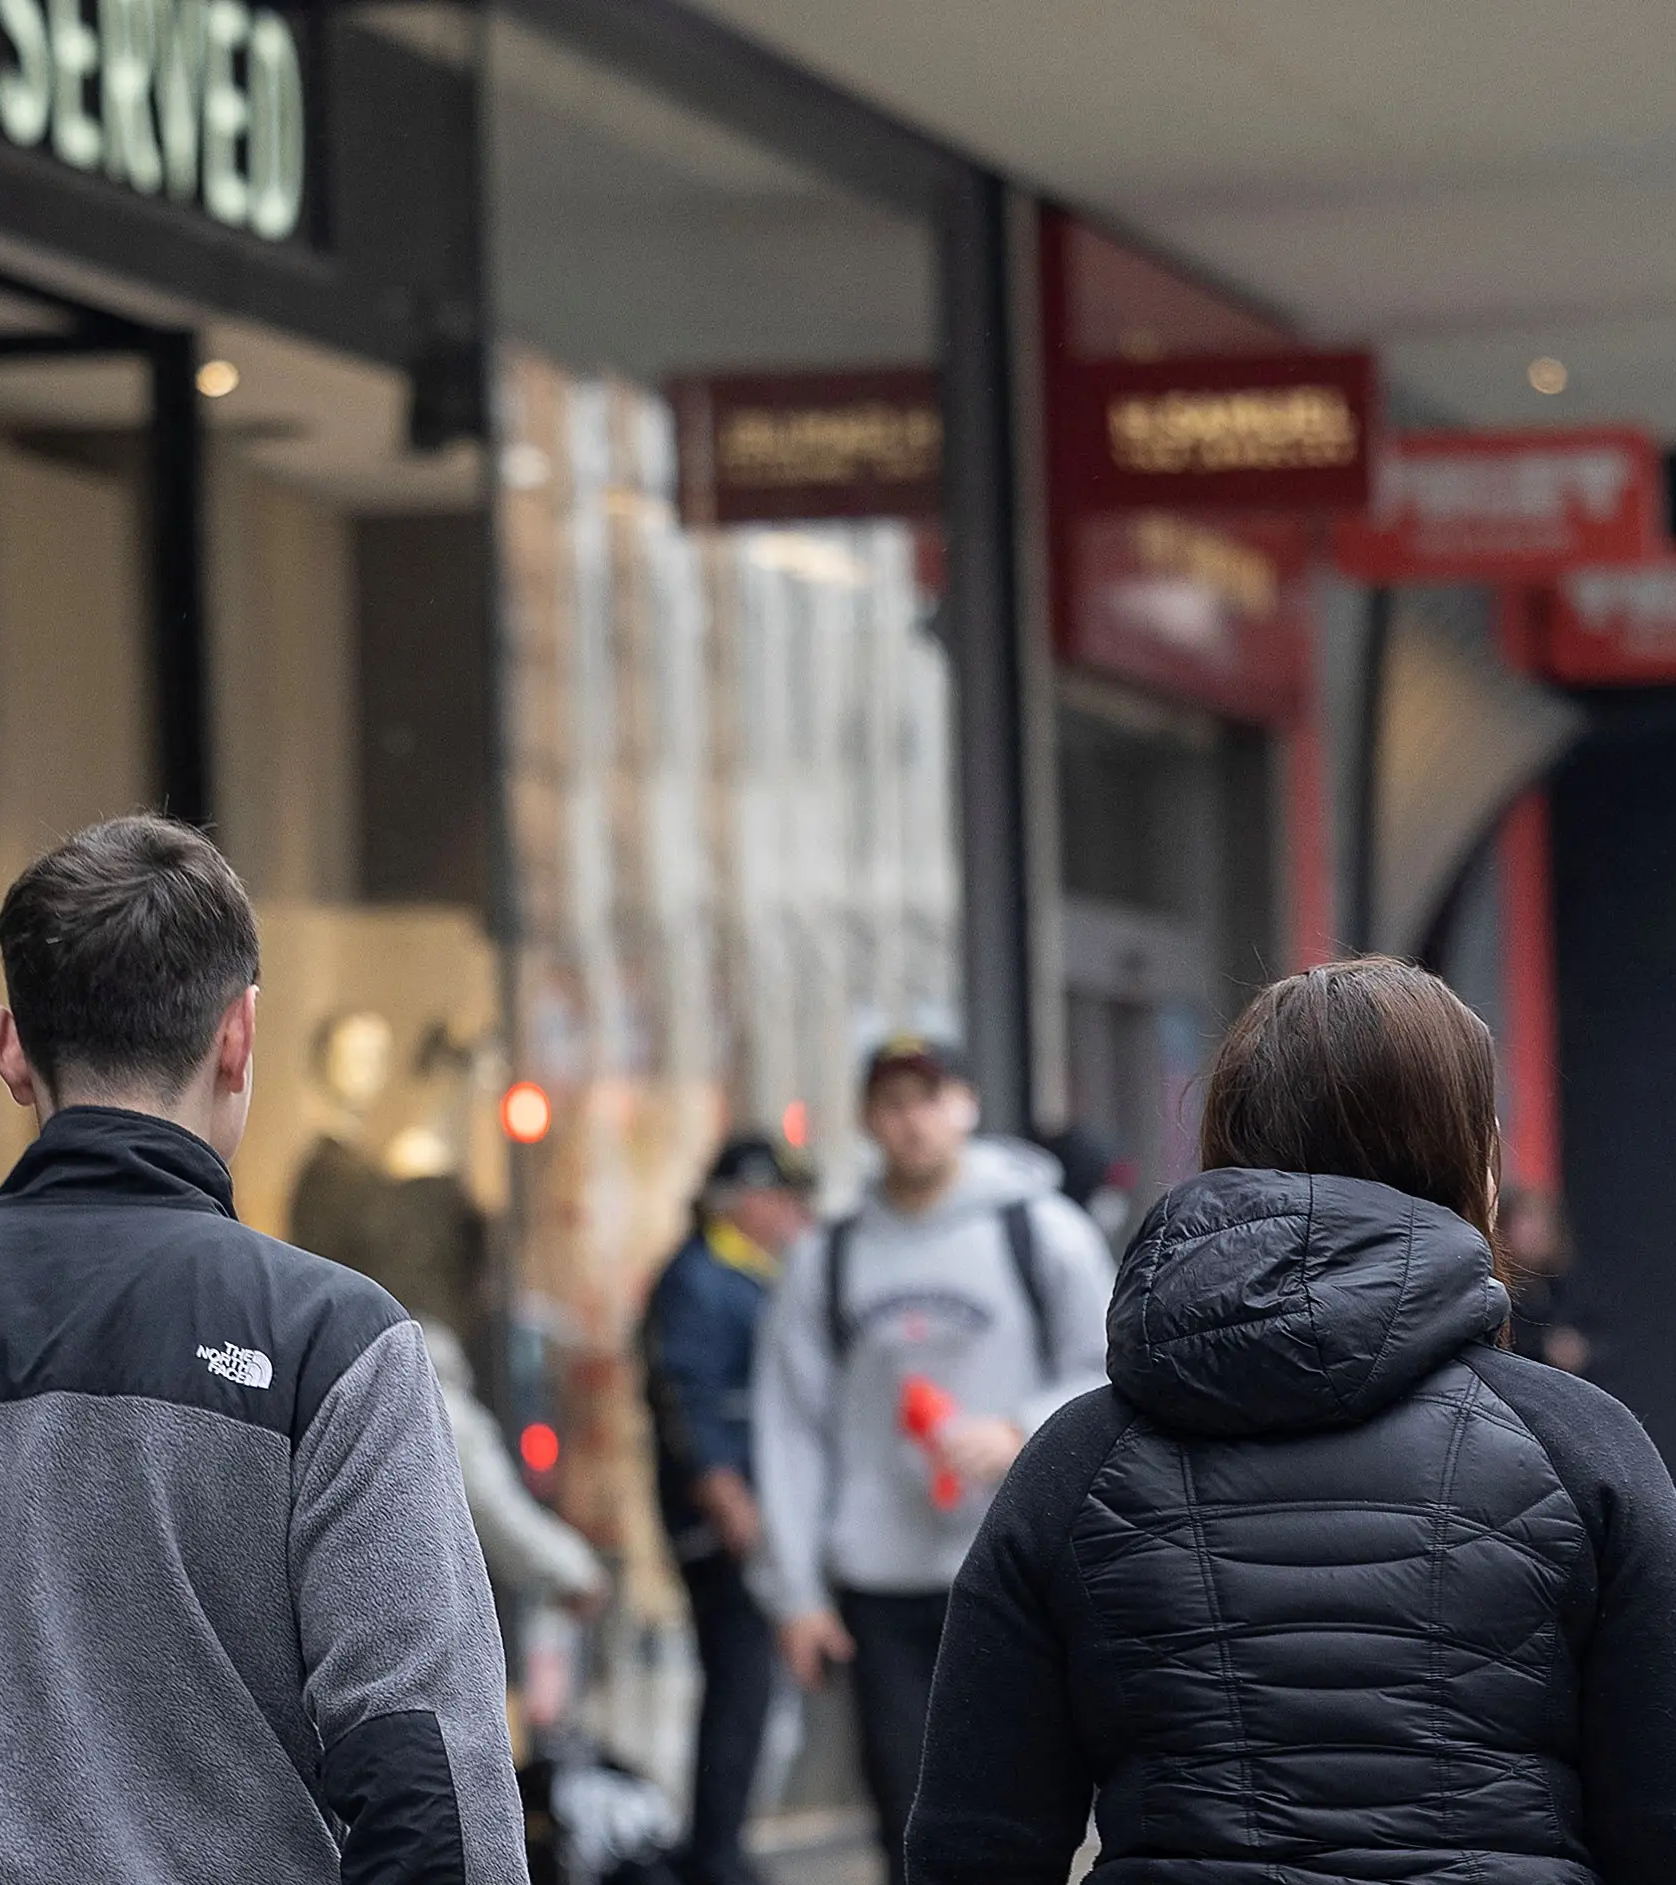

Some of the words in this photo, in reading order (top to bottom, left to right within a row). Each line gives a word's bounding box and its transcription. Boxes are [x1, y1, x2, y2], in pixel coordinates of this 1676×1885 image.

[196, 1344, 249, 1375] NORTH
[224, 1341, 254, 1363] THE
[208, 1361, 249, 1384] FACE
